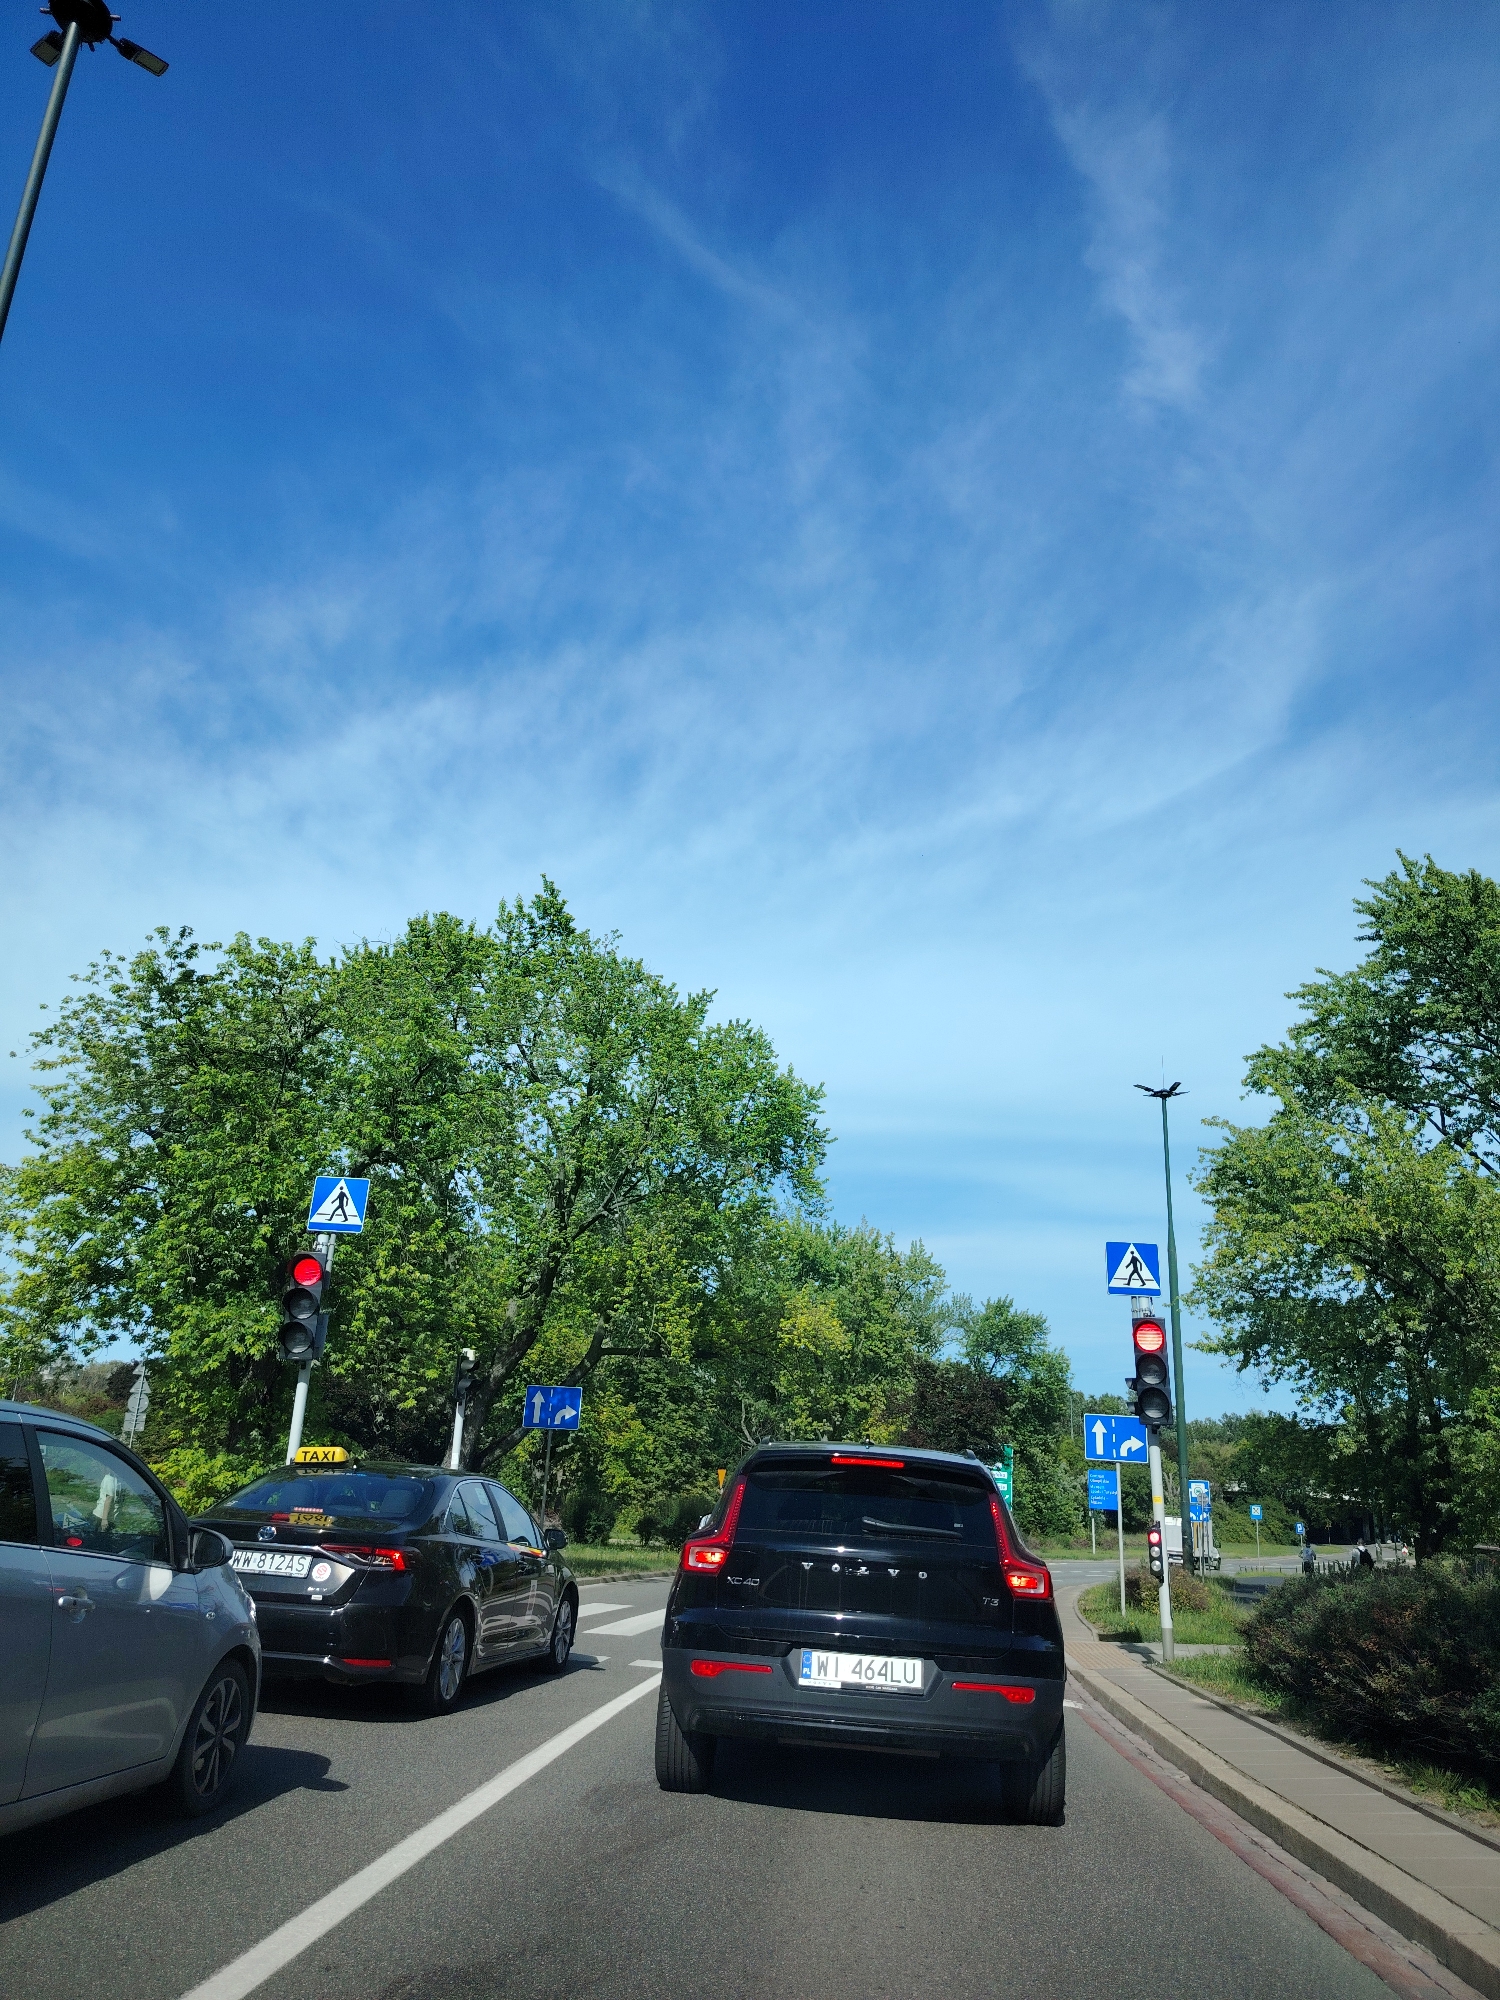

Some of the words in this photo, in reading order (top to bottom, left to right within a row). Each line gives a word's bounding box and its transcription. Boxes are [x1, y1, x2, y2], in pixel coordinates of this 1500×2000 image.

[302, 1450, 336, 1462] TAXI
[231, 1550, 254, 1568] WW
[257, 1552, 306, 1573] 812AS
[801, 1561, 928, 1579] VOLVO
[727, 1576, 760, 1586] XC40
[982, 1596, 1000, 1607] T3
[803, 1667, 811, 1675] PL
[817, 1655, 839, 1678] WI
[851, 1658, 916, 1685] 464LU
